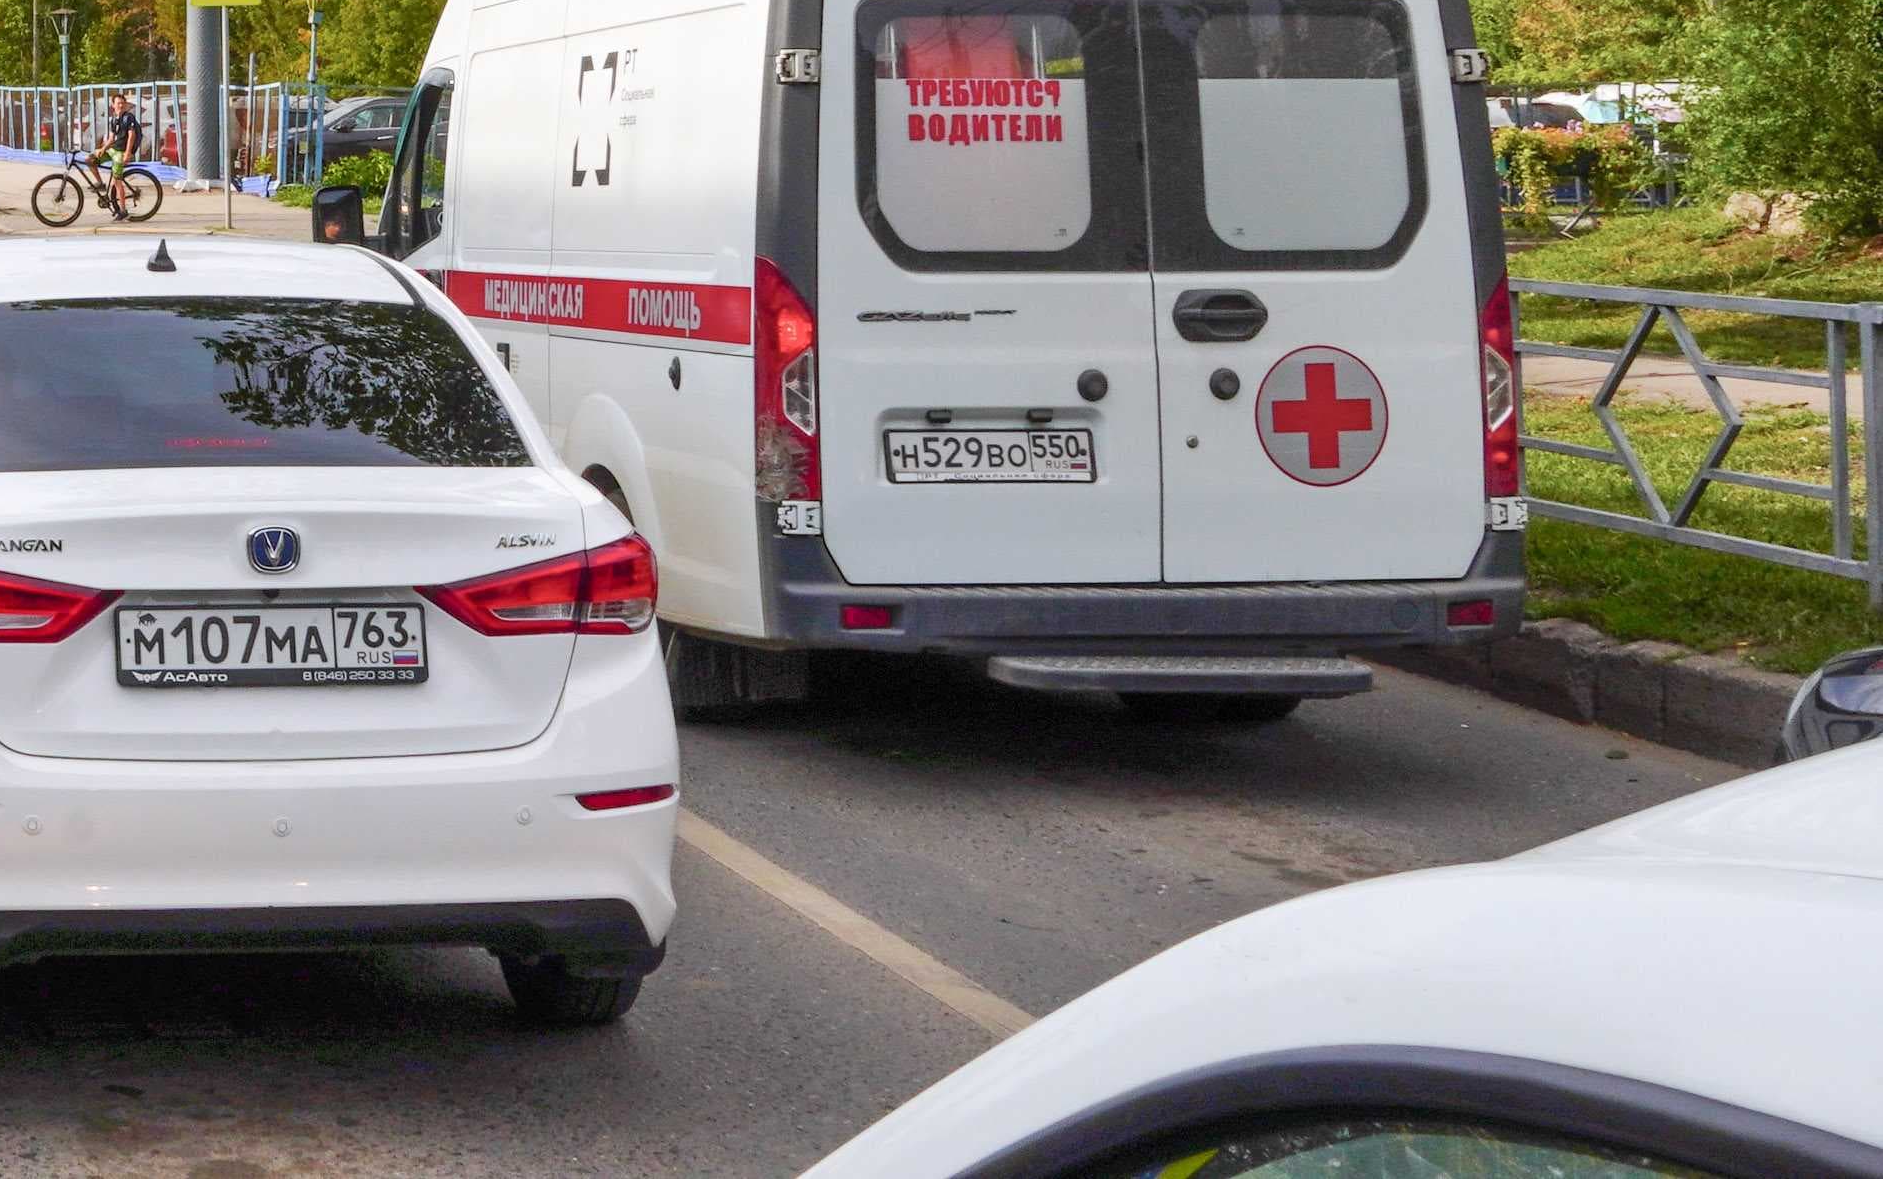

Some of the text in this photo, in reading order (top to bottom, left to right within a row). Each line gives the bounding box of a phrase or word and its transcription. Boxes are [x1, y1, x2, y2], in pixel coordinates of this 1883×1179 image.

[906, 79, 1060, 108] ТРЕБУЮТСЯ
[908, 114, 1063, 146] ВОДИТЕЛИ
[484, 279, 701, 337] МЕДИЦИНСКАЯ ПОМОЩЬ
[901, 434, 1080, 469] Н529ВО 550
[1045, 460, 1069, 470] RUS
[495, 533, 556, 549] ALSVIN
[134, 611, 409, 665] М107МА 763
[357, 651, 391, 664] RUS
